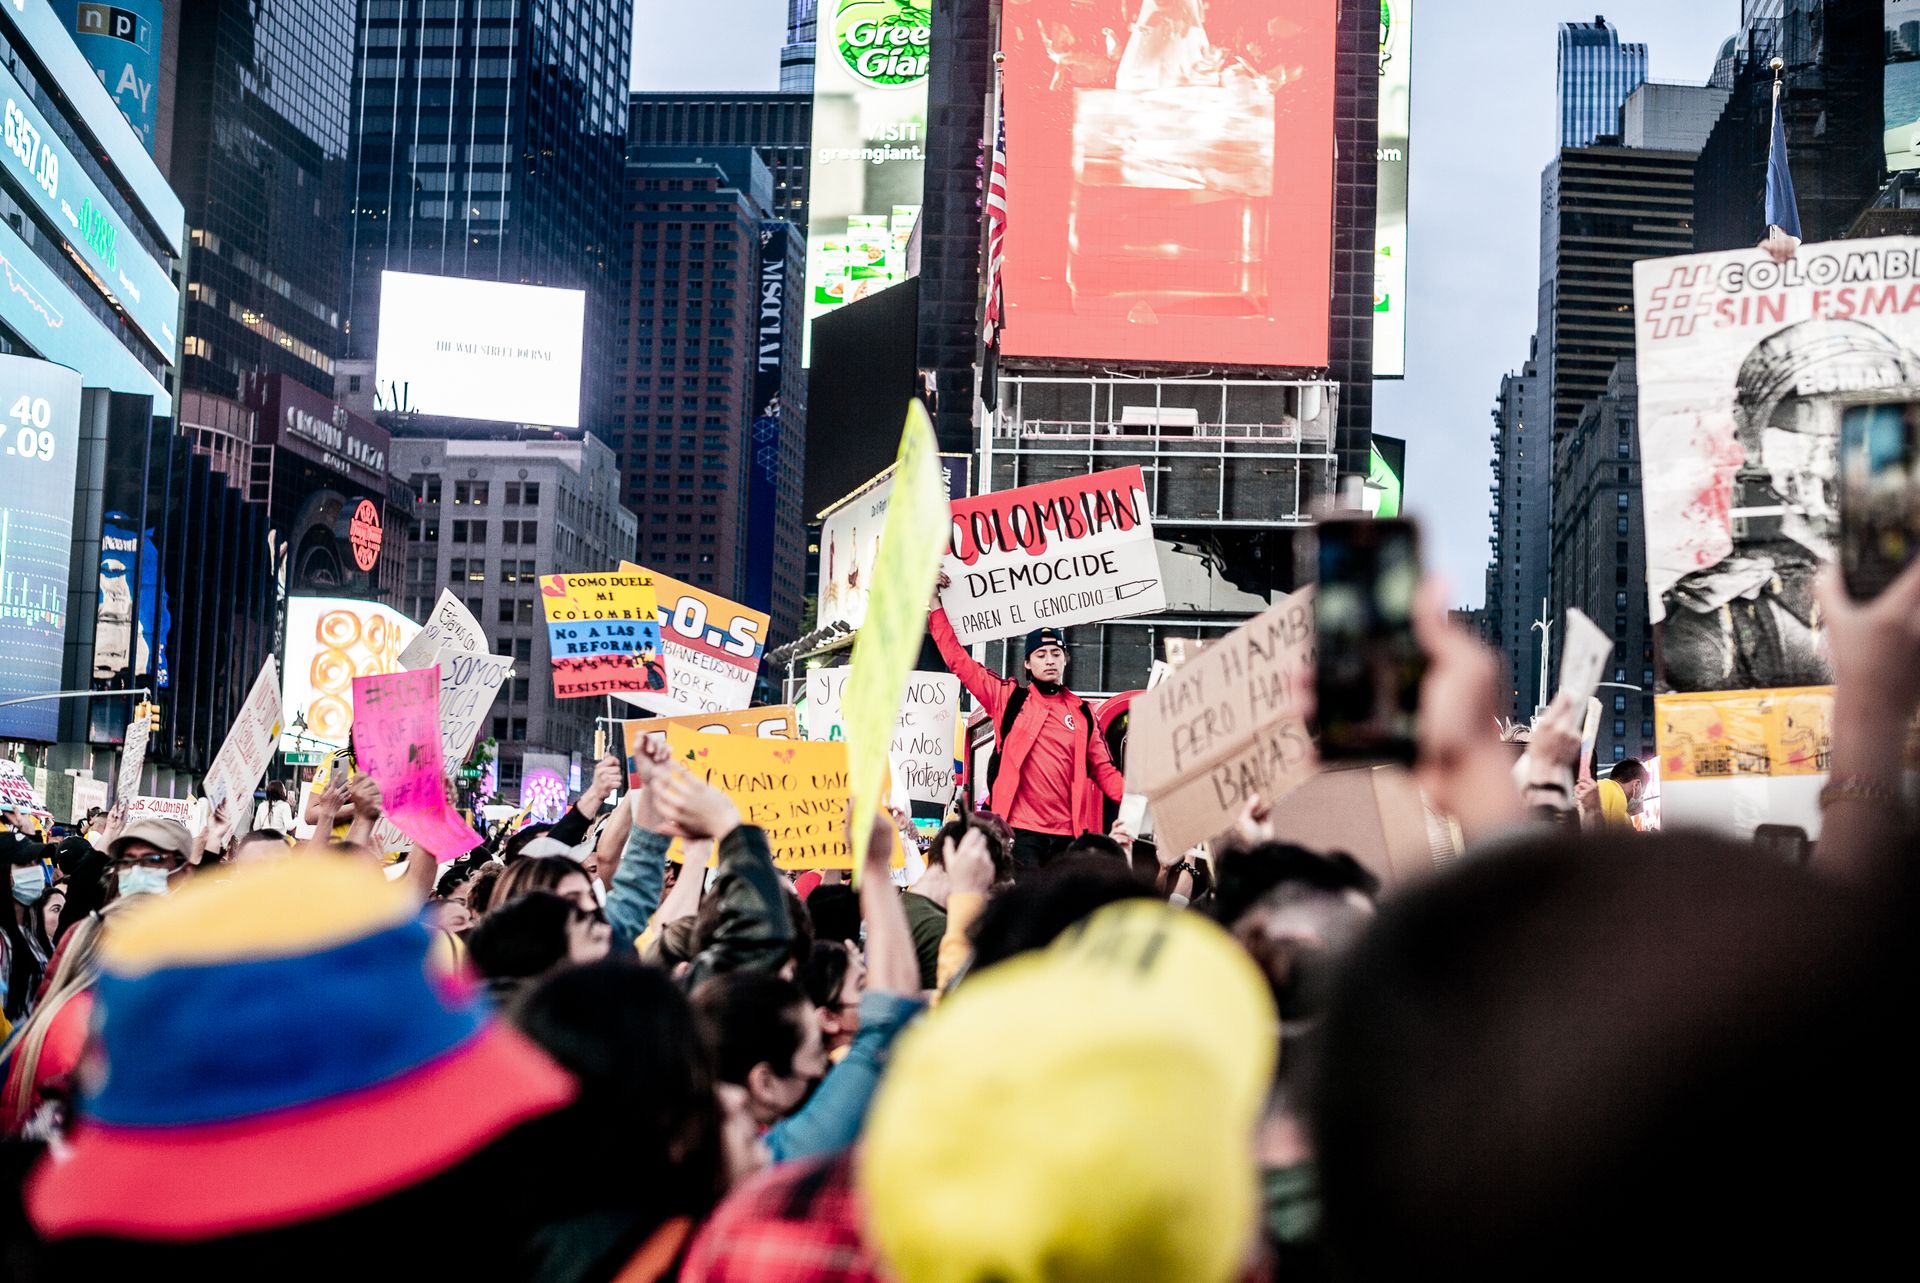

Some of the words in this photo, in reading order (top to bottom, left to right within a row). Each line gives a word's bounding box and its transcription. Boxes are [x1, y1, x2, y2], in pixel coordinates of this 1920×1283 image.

[85, 9, 147, 42] npr
[864, 122, 921, 141] VISIT
[1714, 294, 1785, 328] SIN
[481, 345, 513, 358] STREET
[517, 348, 551, 361] JOURNAL
[950, 485, 1140, 561] COLOMBIAN
[568, 577, 607, 587] COMO
[611, 577, 655, 587] DUELE
[964, 550, 1118, 598] DEMOCIDE
[962, 609, 1002, 634] PAREN
[1010, 604, 1026, 625] EL
[1033, 588, 1105, 620] GENOCIDIO
[567, 641, 653, 654] REFORMAS
[589, 627, 600, 638] A
[606, 625, 635, 637] LAS
[441, 655, 507, 689] SOMOS
[672, 668, 714, 695] YORK
[1171, 702, 1237, 773] PERO
[899, 759, 953, 798] Proteger
[1211, 722, 1307, 812] BALAS
